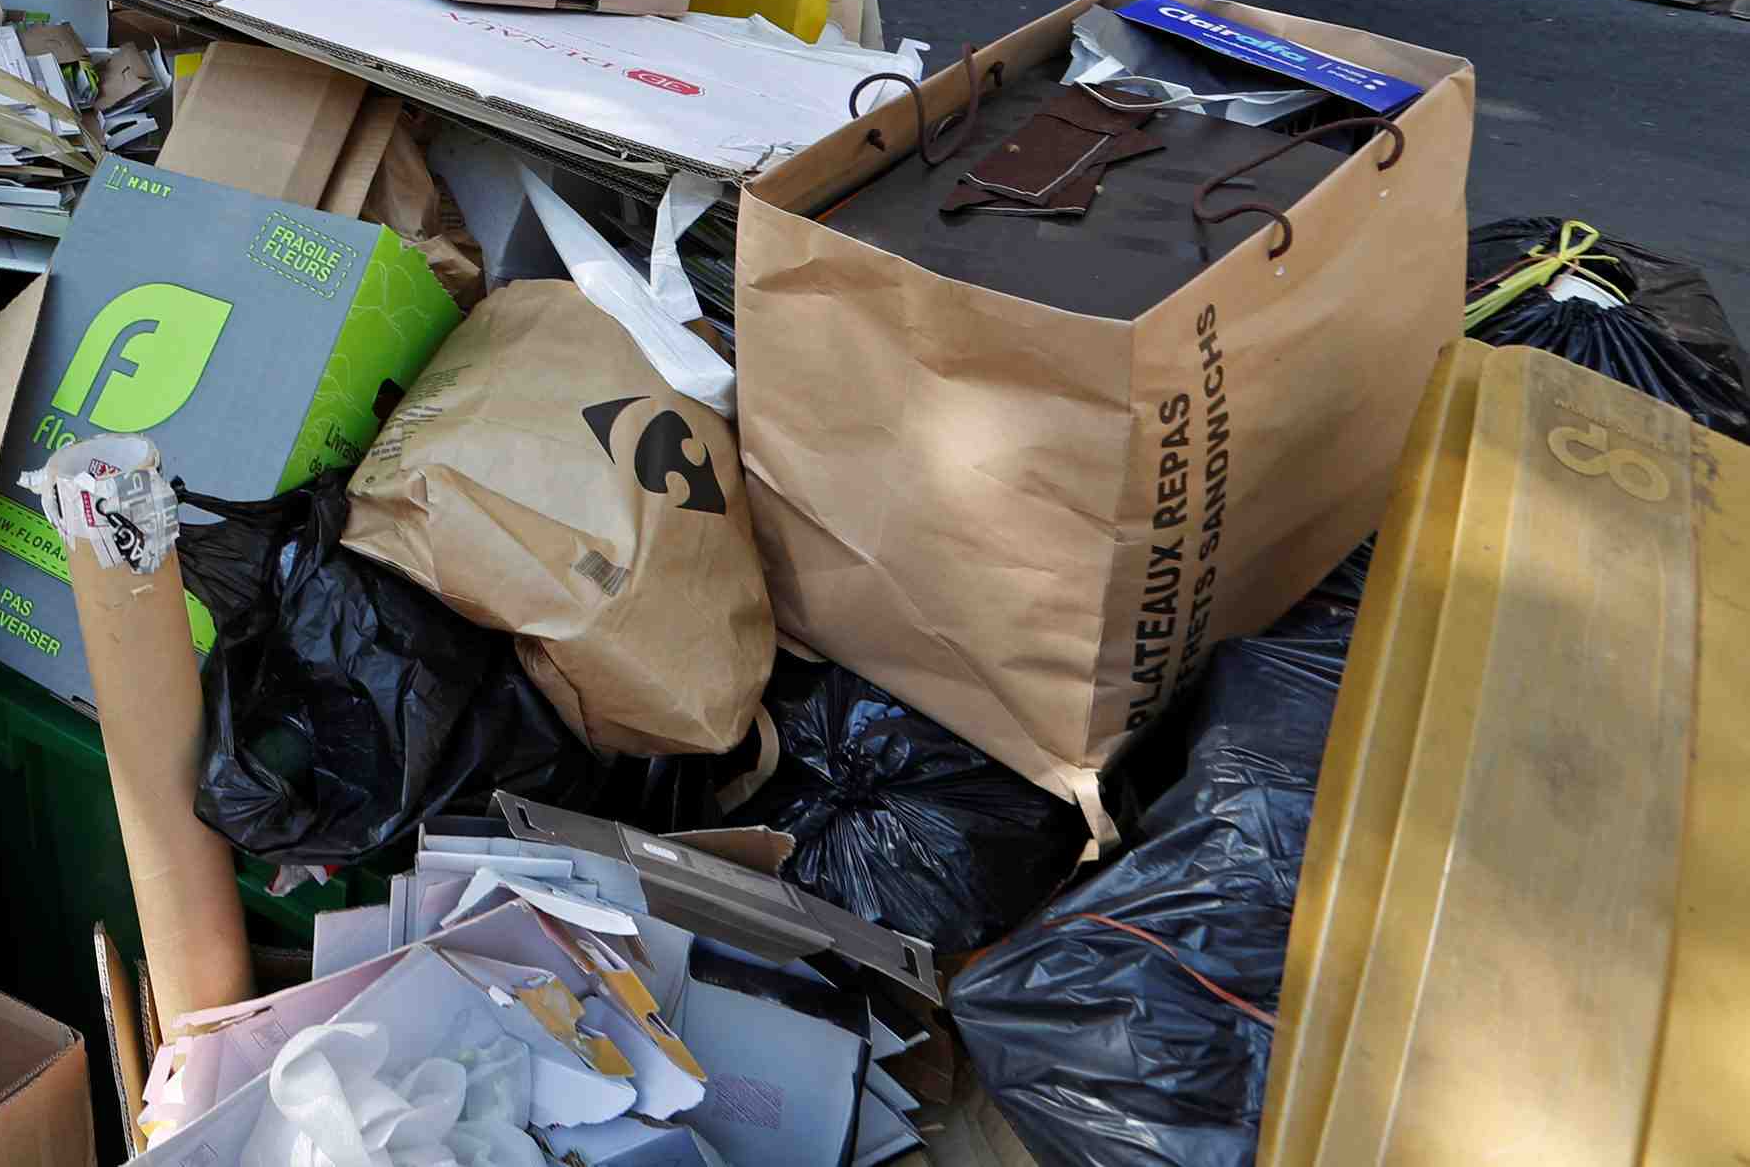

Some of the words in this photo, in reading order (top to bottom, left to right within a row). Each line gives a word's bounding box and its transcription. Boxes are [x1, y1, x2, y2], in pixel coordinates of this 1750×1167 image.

[1158, 7, 1309, 63] Clairalfa
[127, 176, 172, 198] HAUT
[262, 240, 331, 283] FLEURS
[271, 225, 342, 269] FRAGILE
[1196, 303, 1230, 562] SANDWICHS
[1153, 391, 1191, 530] REPAS
[0, 584, 34, 617] PAS
[1127, 537, 1184, 733] PLATEAUX
